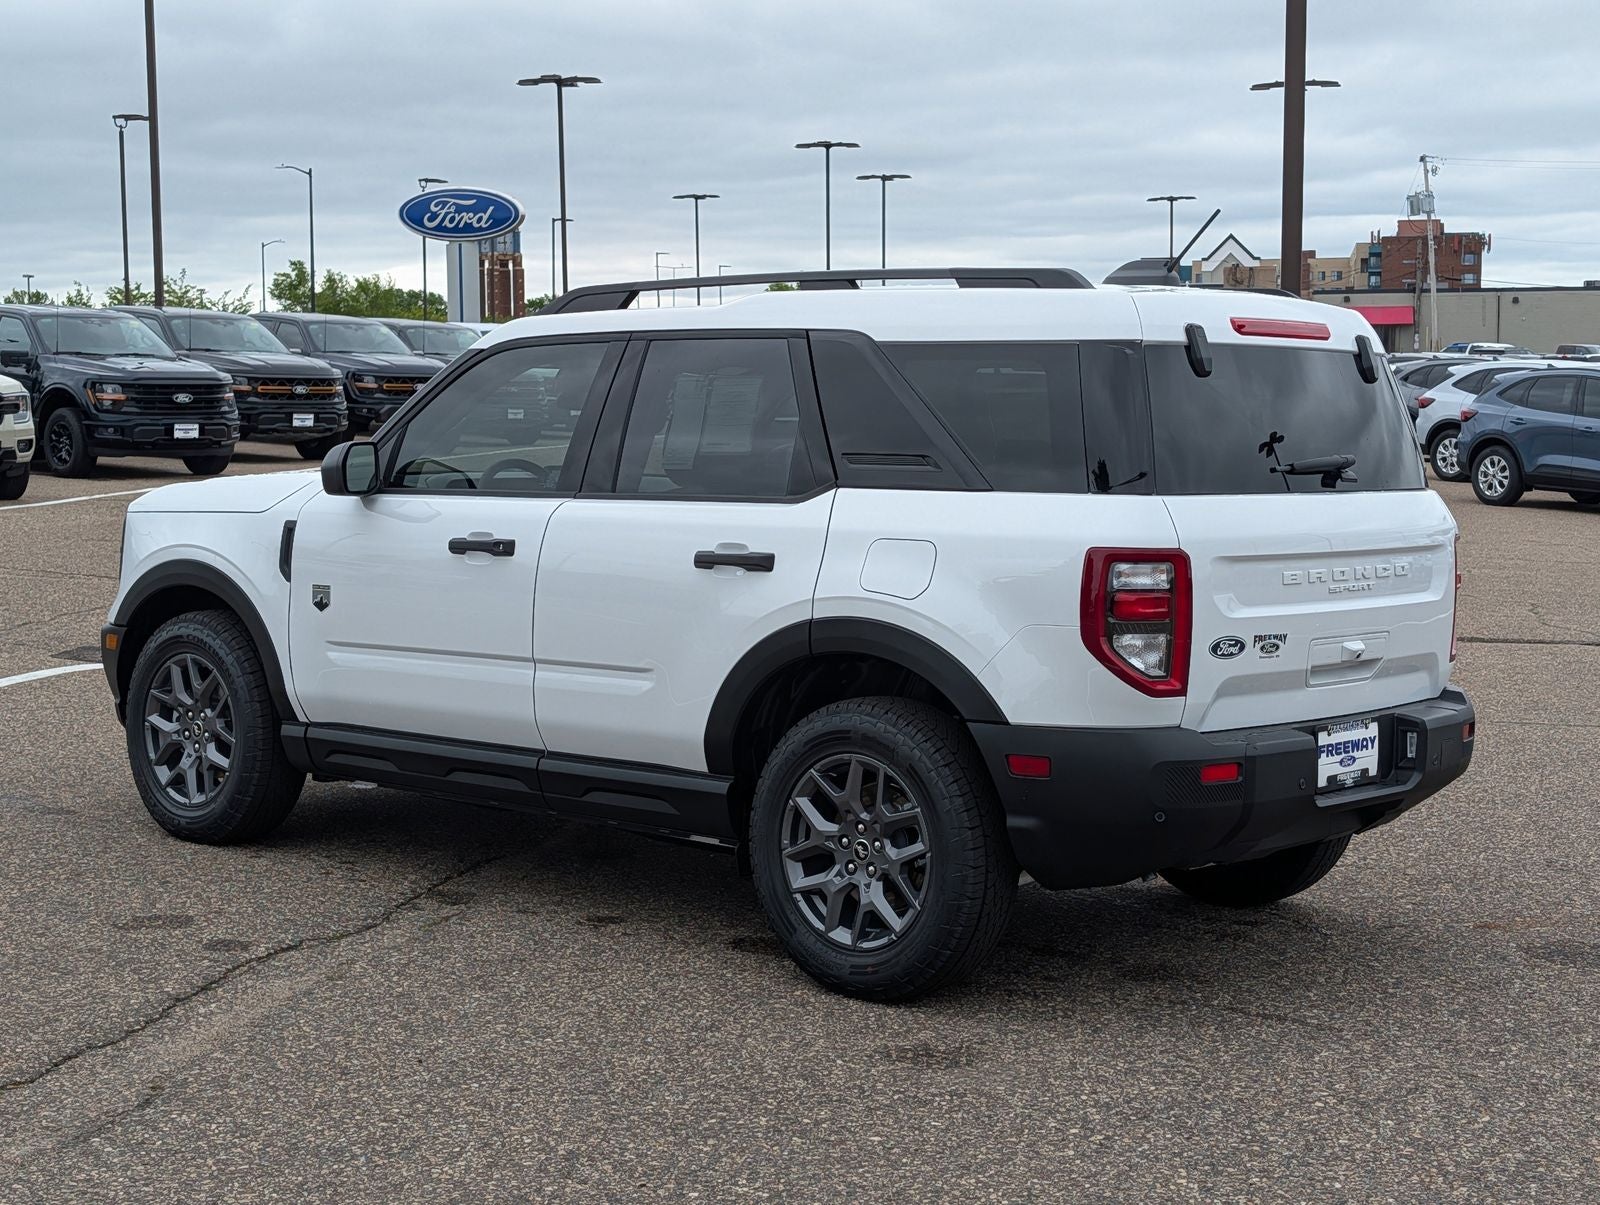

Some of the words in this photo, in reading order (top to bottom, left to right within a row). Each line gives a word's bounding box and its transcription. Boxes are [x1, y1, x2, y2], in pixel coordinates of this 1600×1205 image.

[423, 198, 494, 229] Ford
[1282, 563, 1409, 585] BRONCO
[1328, 582, 1376, 593] SPORT
[1217, 640, 1241, 656] Ford
[1253, 633, 1288, 648] FREEWAY
[1317, 735, 1377, 759] FREEWAY
